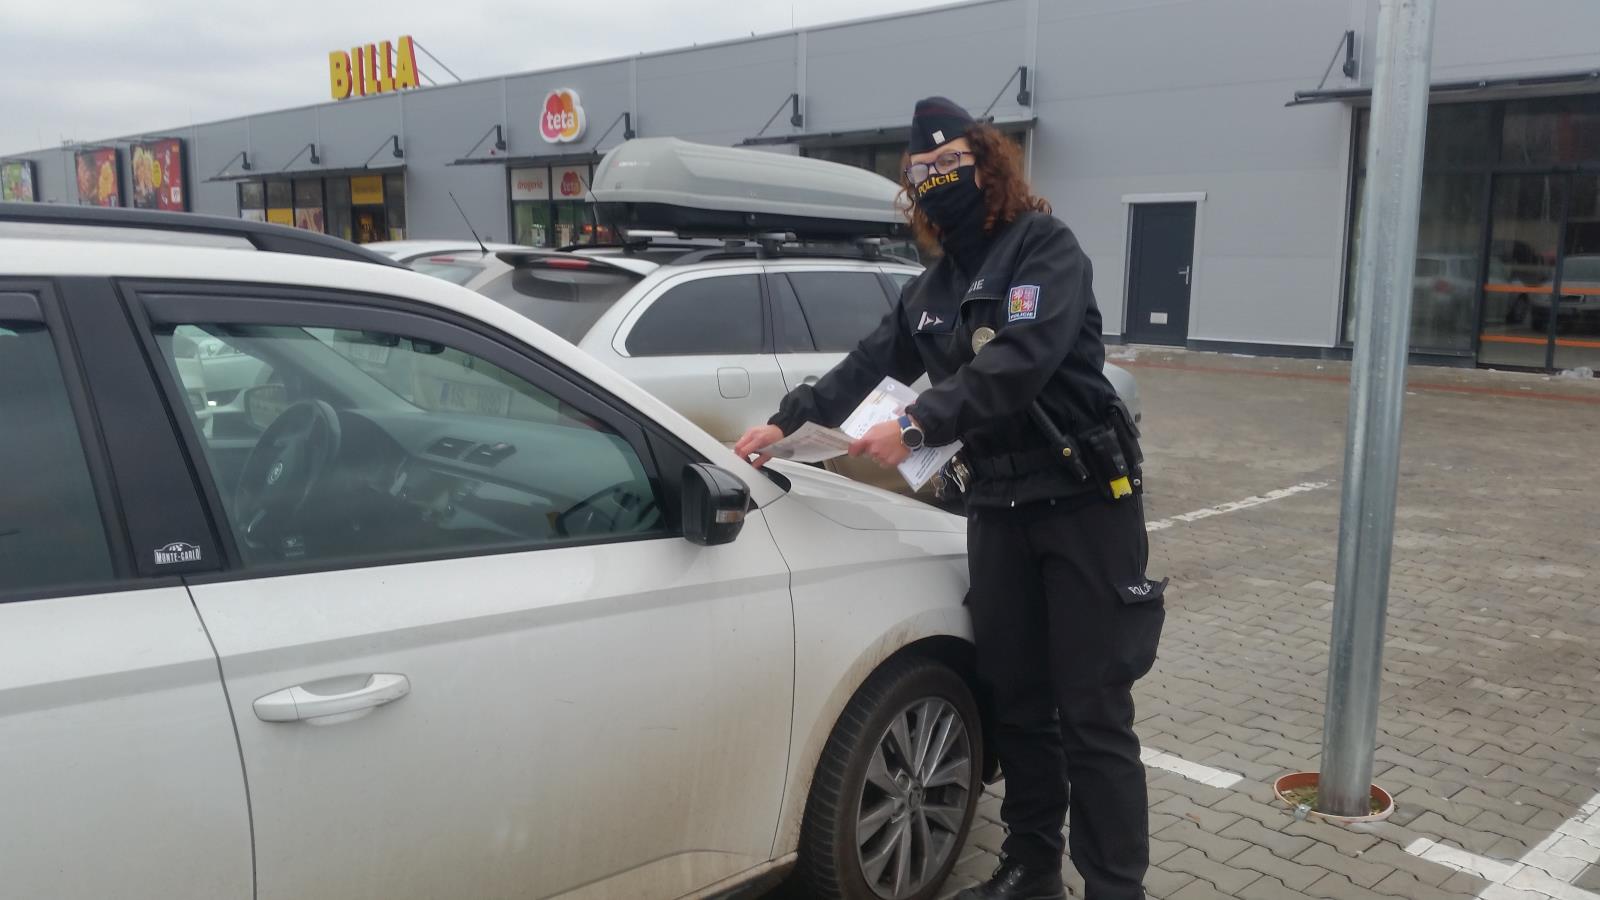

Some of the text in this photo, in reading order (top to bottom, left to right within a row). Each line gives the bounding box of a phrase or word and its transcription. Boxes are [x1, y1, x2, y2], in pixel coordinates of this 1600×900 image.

[329, 35, 420, 100] BILLA
[546, 109, 575, 130] teta
[918, 170, 960, 197] POLICIE
[1010, 311, 1033, 319] POLICIE
[155, 548, 200, 563] MONTE-CARLO
